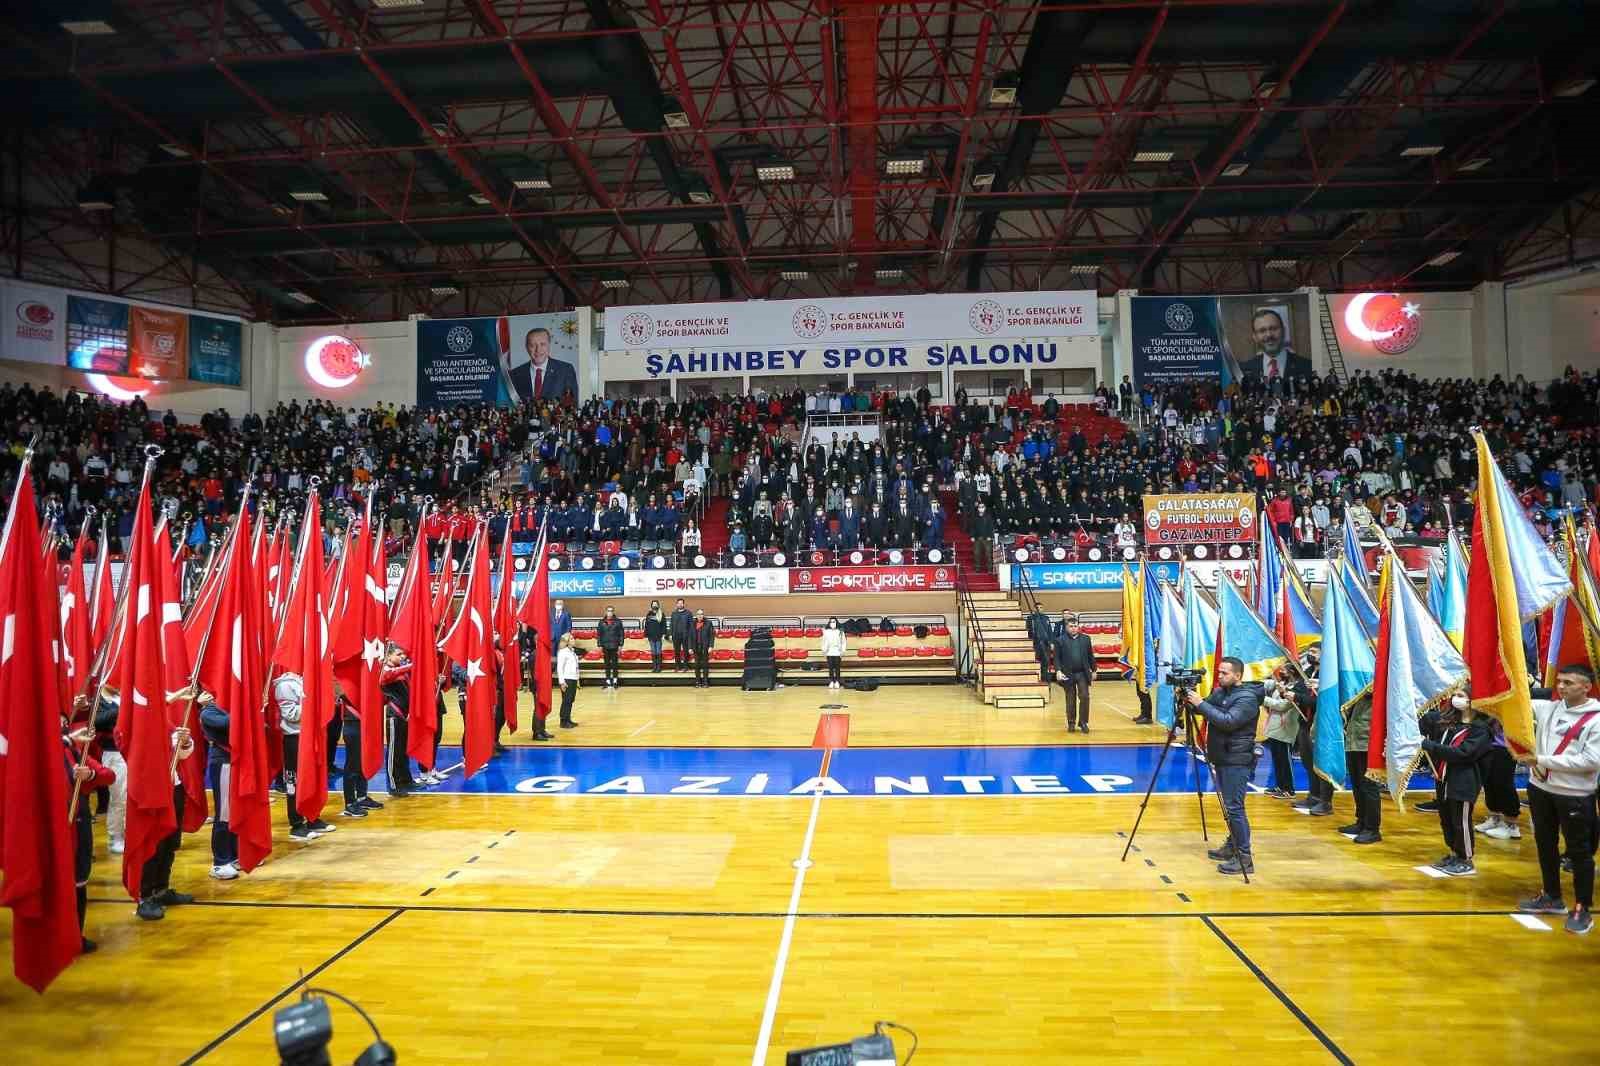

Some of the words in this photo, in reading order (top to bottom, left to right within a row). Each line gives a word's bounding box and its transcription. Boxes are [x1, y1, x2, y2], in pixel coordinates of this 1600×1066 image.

[830, 312, 847, 321] T.C.
[848, 311, 889, 321] GENÇLİK
[891, 311, 904, 319] VE
[1007, 308, 1024, 316] T.C.
[1025, 306, 1067, 316] GENÇLİK
[1070, 306, 1083, 314] VE
[656, 320, 673, 328] T.C.
[674, 317, 714, 328] GENÇLİK
[717, 317, 729, 326] VE
[830, 322, 852, 331] SPOR
[855, 320, 905, 330] BAKANLIĞI
[1007, 318, 1031, 326] SPOR
[1033, 316, 1083, 325] BAKANLIĞI
[656, 329, 679, 337] SPOR
[681, 326, 729, 336] BAKANLIĞI
[646, 350, 808, 378] ŞAHINBEY
[823, 347, 908, 369] SPOR
[927, 343, 1057, 366] SALONU
[1158, 498, 1240, 511] GALATASARAY
[1167, 514, 1202, 524] FUTBOL
[1205, 513, 1234, 523] OKULU
